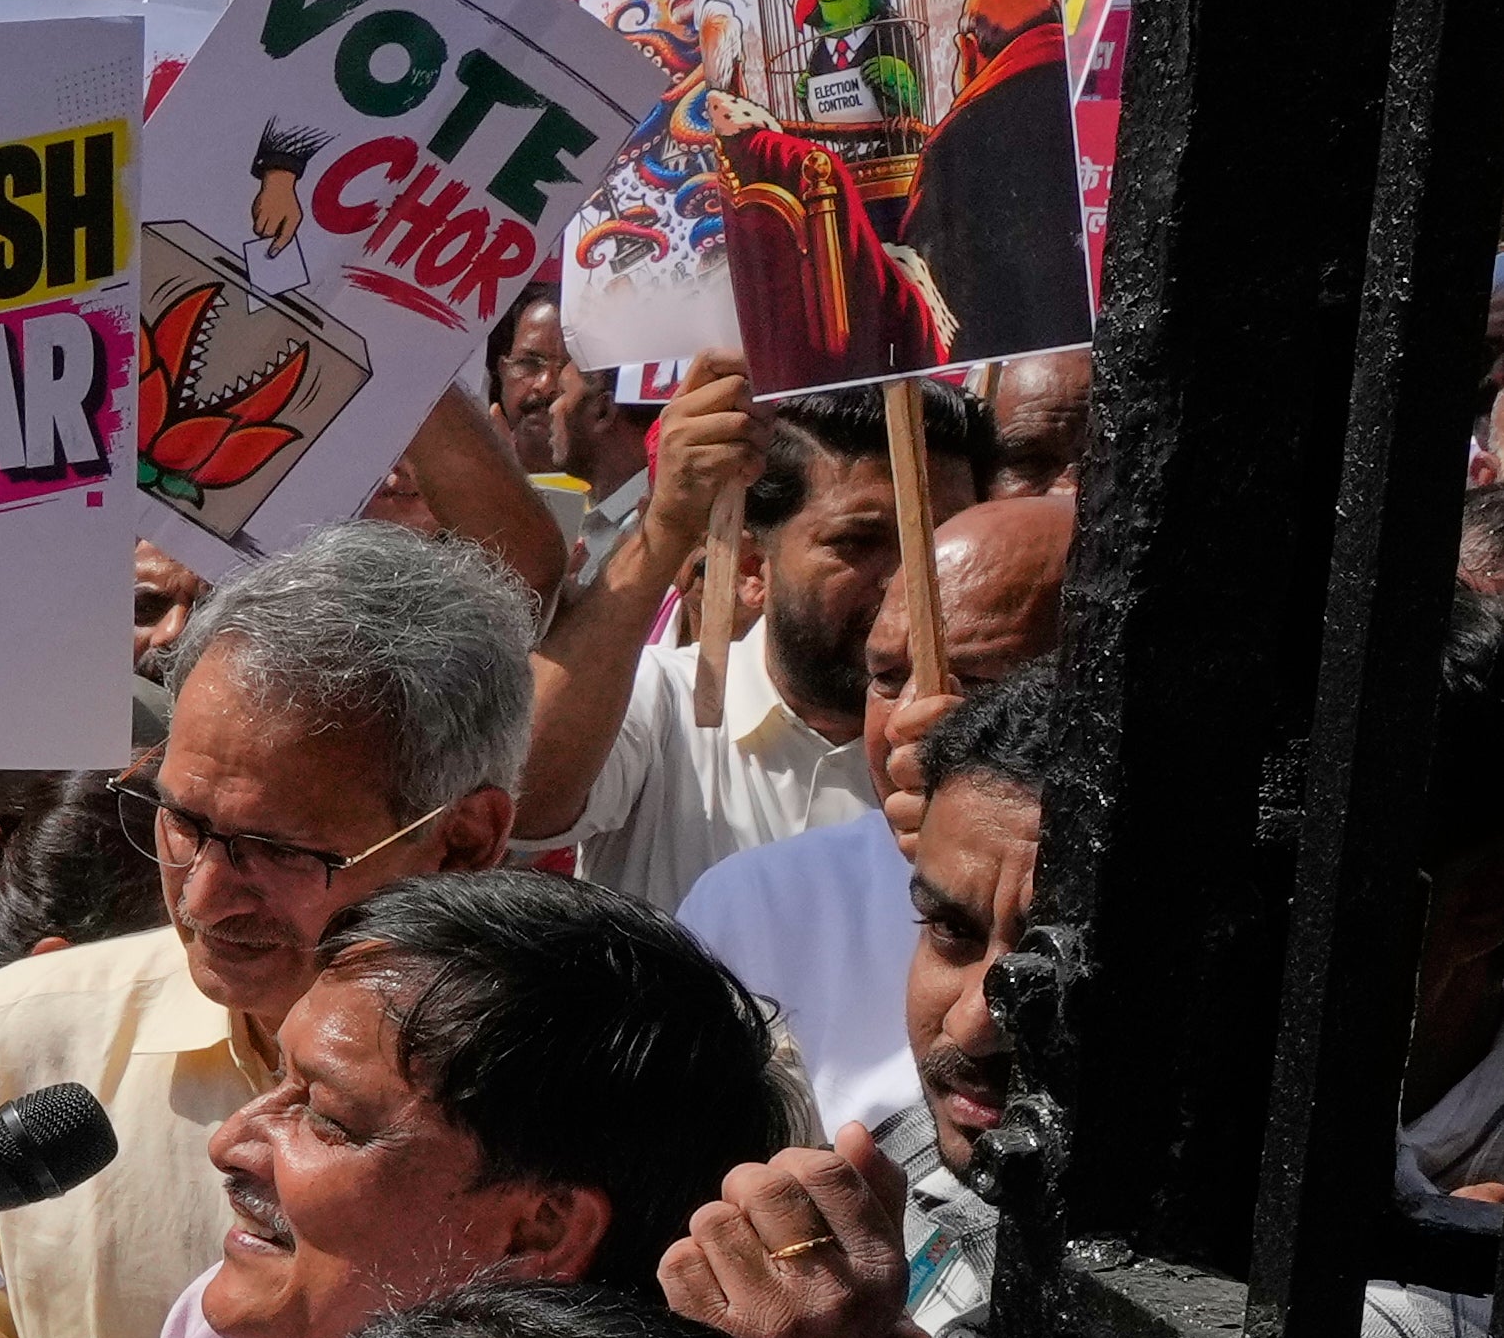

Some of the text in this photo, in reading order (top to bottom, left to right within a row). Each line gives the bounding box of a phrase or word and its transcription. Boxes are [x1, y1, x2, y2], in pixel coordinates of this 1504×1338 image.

[814, 78, 860, 100] ELECTION
[818, 94, 863, 113] CONTROL
[311, 136, 537, 323] CHOR
